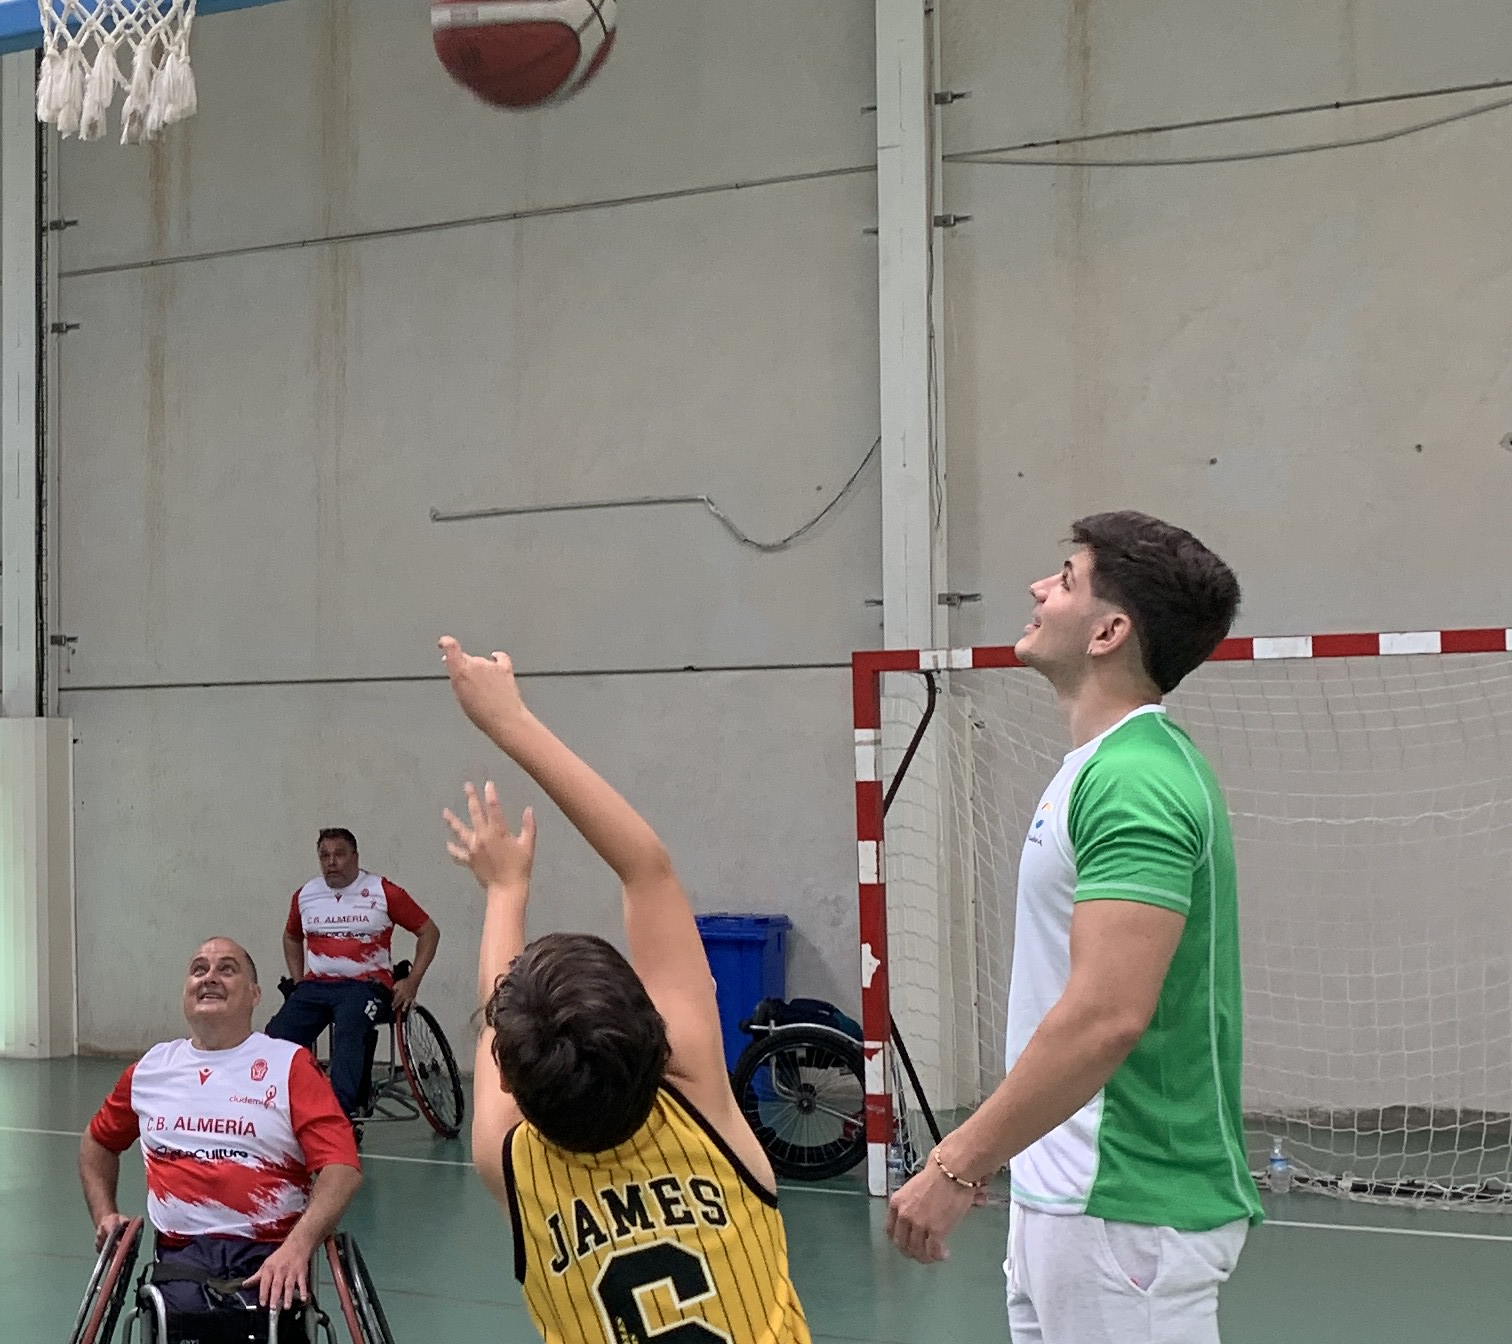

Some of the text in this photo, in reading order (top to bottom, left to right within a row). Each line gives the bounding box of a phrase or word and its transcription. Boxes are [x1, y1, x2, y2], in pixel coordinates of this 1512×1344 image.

[324, 913, 370, 924] ALMERÍA
[147, 1116, 257, 1138] C.B. ALMERÍA
[546, 1173, 730, 1277] JAMES
